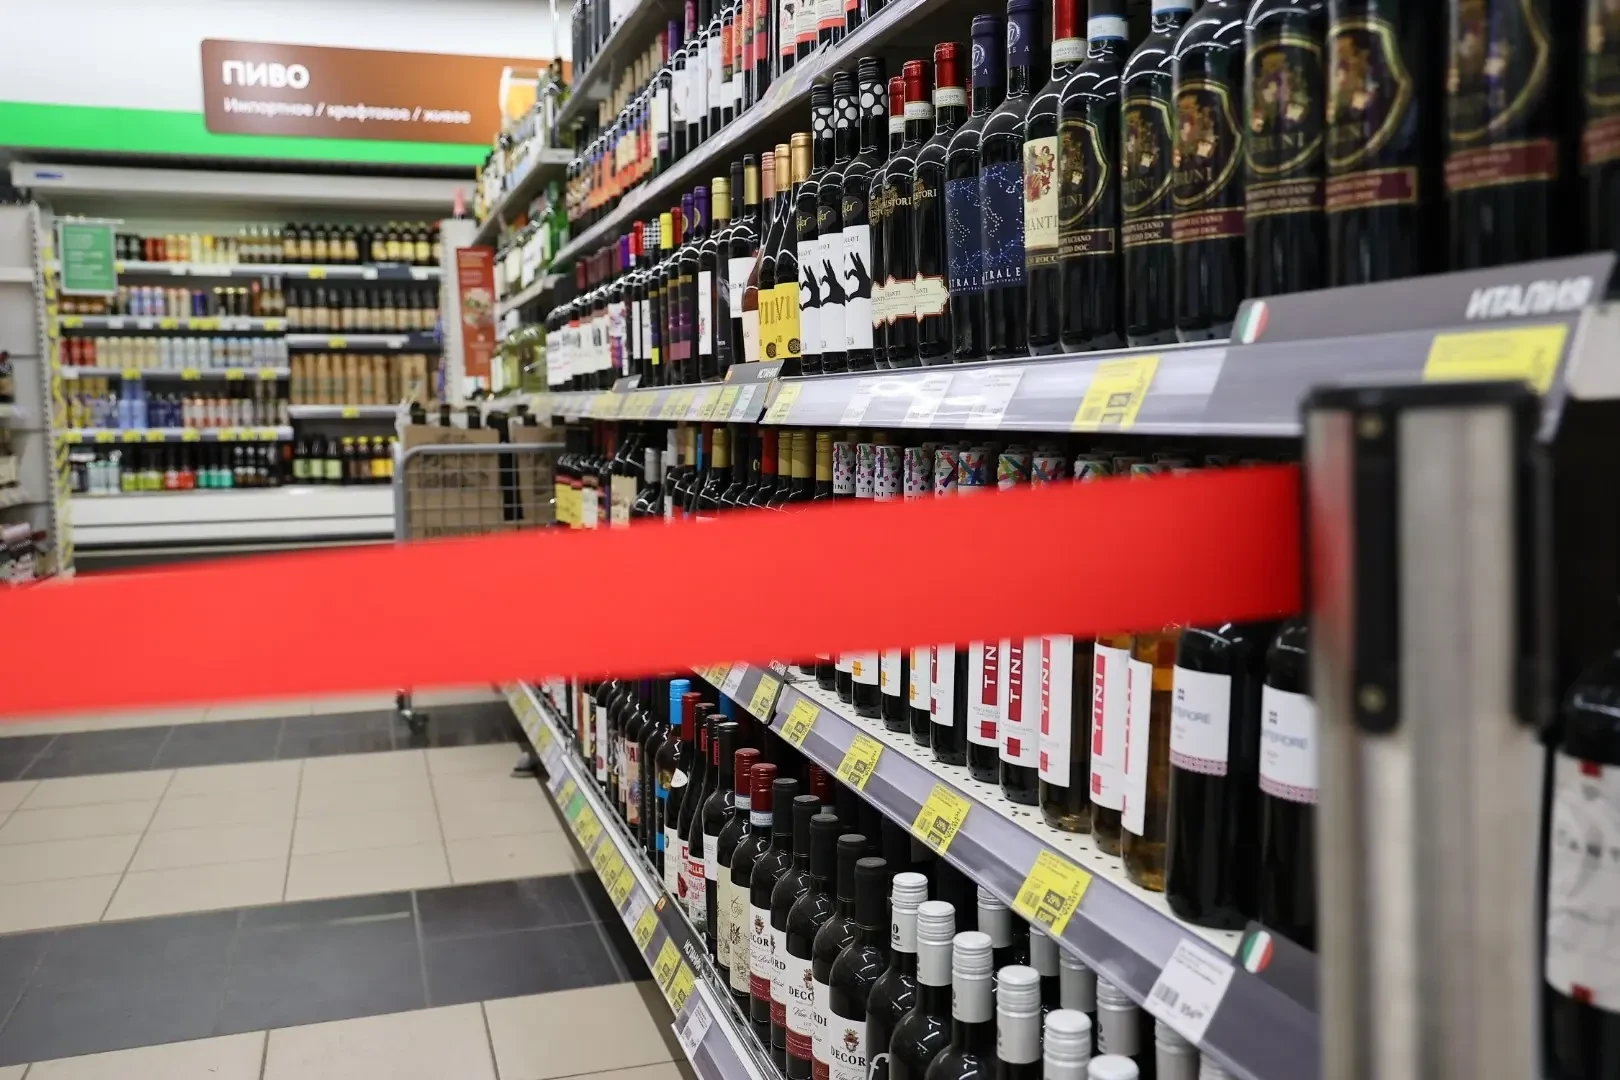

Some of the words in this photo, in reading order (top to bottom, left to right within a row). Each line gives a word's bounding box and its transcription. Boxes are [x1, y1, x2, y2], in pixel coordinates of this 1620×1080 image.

[221, 60, 310, 90] ПИВО
[223, 96, 314, 118] Импортное
[326, 102, 411, 123] крафтовое
[422, 108, 472, 125] живое
[1465, 275, 1593, 320] ИТАЛИЯ
[1009, 647, 1022, 704] TINI
